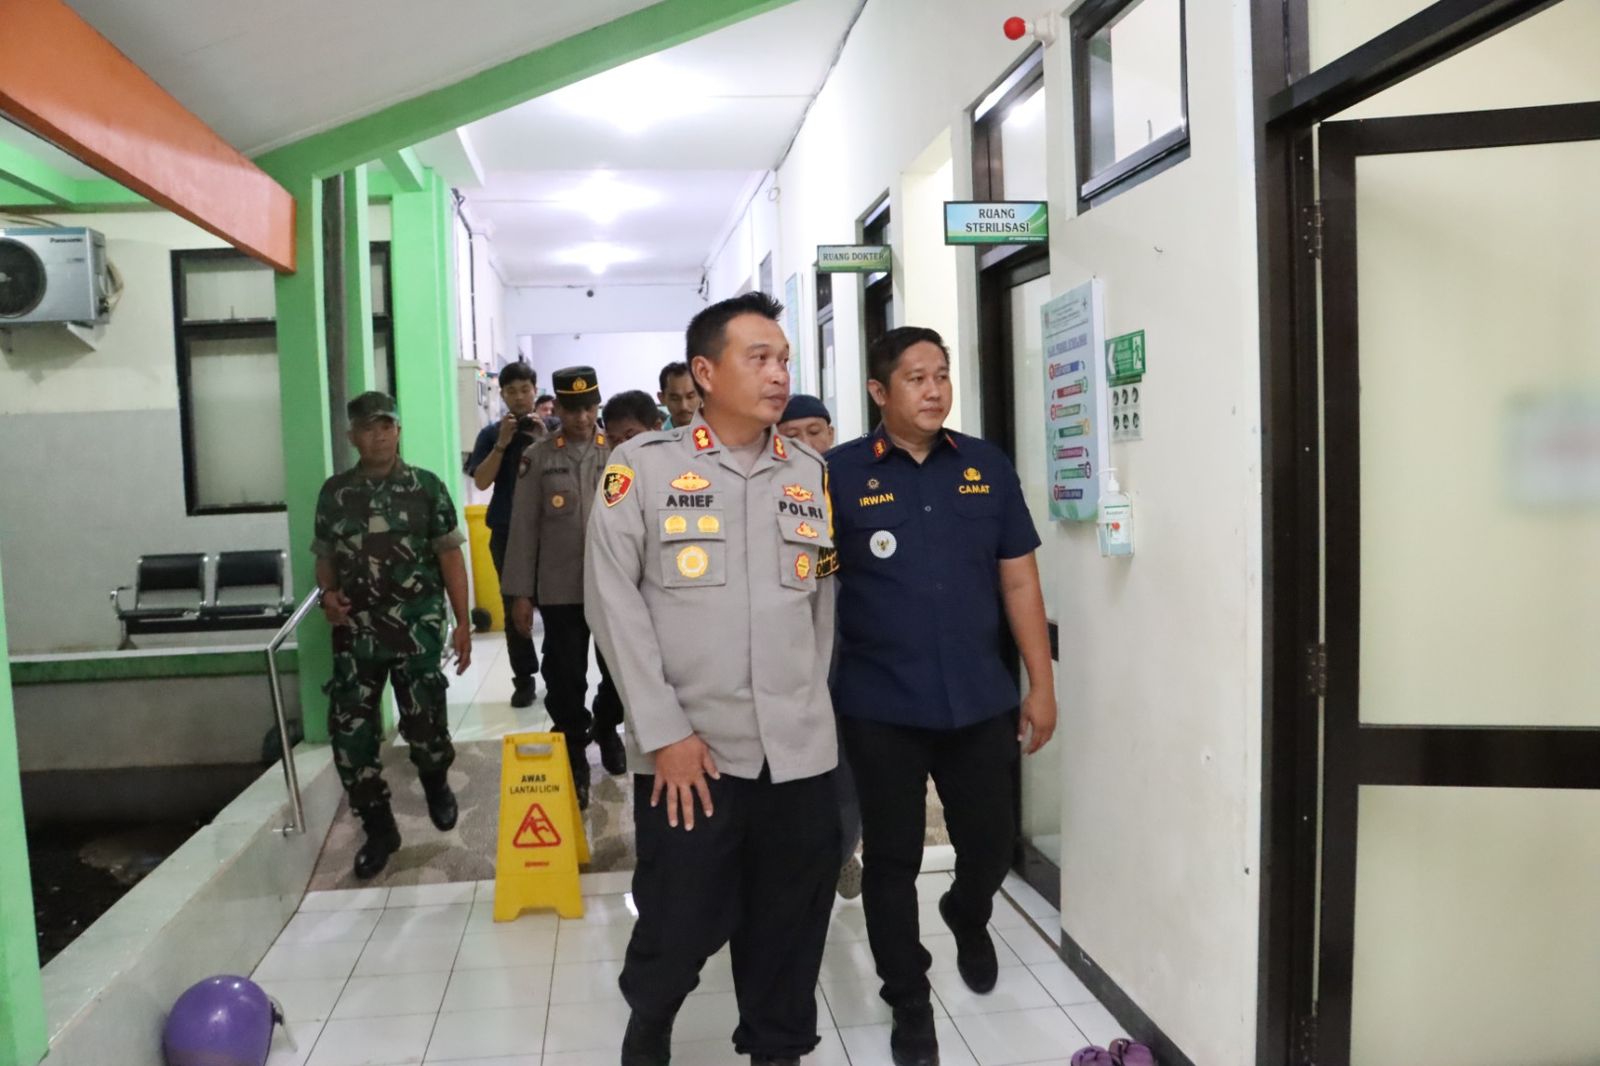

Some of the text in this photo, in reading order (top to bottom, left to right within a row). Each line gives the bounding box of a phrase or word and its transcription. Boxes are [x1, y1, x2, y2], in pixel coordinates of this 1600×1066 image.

[978, 208, 1015, 219] RUANG
[965, 222, 1030, 233] STERILISASI
[823, 252, 885, 261] RUANG DOKTER
[958, 484, 991, 495] CAMAT
[666, 494, 715, 508] ARIEF
[859, 492, 895, 507] IRWAN
[778, 500, 824, 519] POLRI
[521, 774, 546, 782] AWAS
[510, 785, 560, 794] LANTAI LICIN
